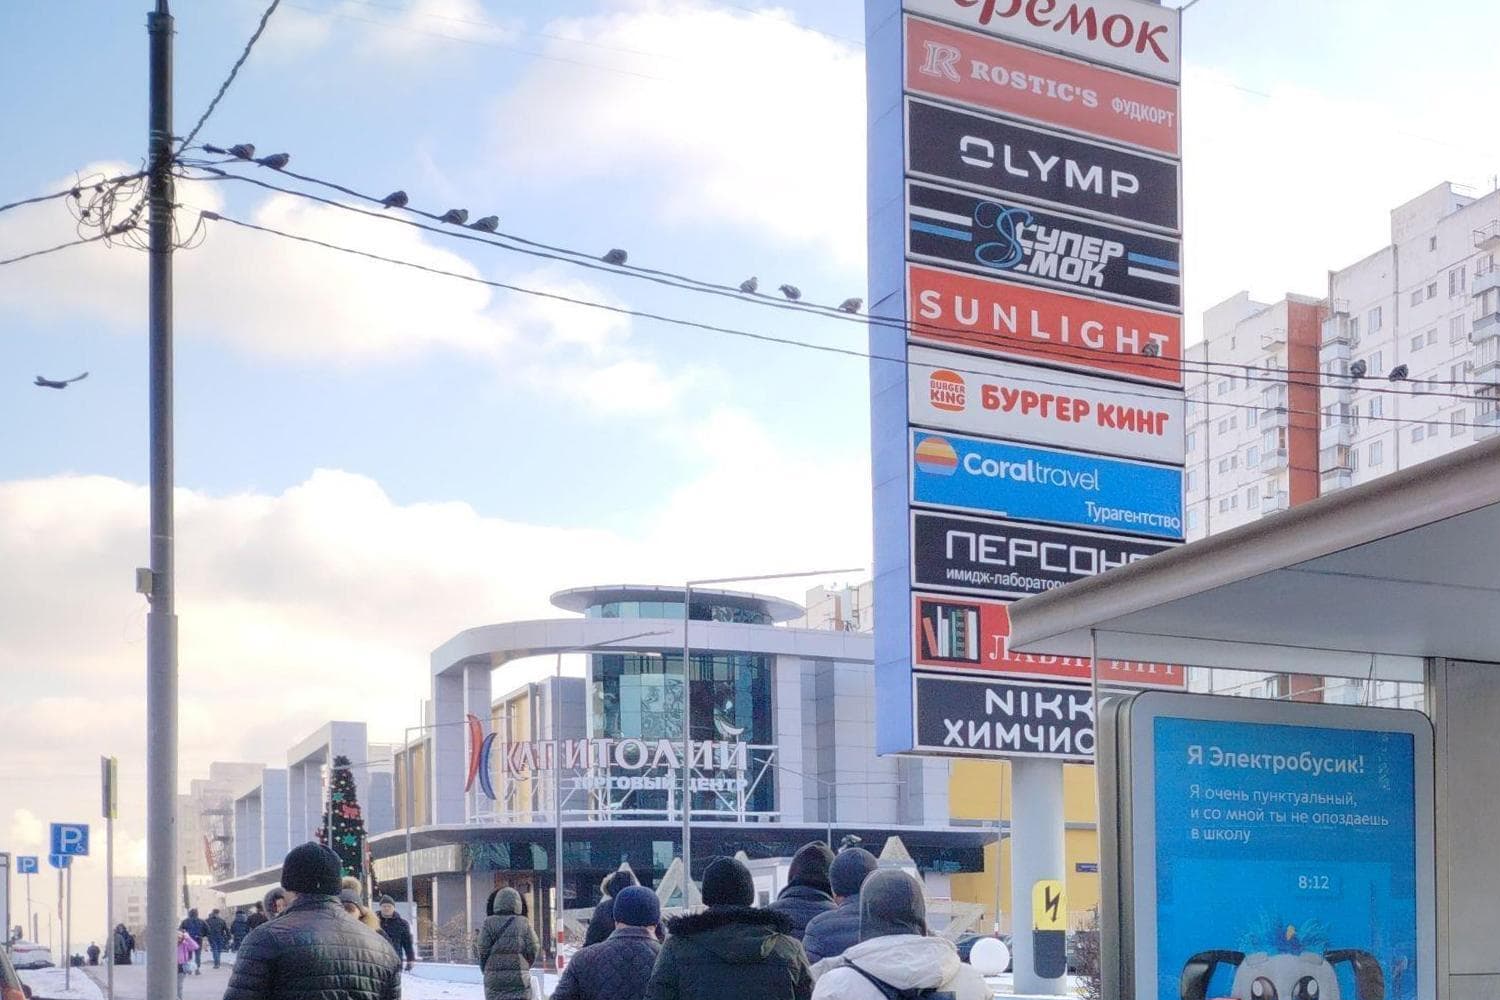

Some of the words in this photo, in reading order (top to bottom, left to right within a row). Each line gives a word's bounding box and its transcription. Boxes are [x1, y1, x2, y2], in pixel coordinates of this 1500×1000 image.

[952, 0, 1170, 63] ремок
[970, 59, 1099, 109] ROSTIC'S
[1111, 97, 1175, 128] ФУДКОРТ
[960, 135, 1140, 198] OLYMP
[1015, 222, 1124, 263] СУПЕР
[919, 289, 1169, 357] SUNLIGHT
[930, 380, 965, 395] BURGER
[930, 389, 965, 406] KING
[981, 384, 1090, 423] БУРГЕР
[1097, 402, 1169, 436] КИНГ
[1084, 500, 1180, 530] Турагентство
[946, 567, 1067, 591] имидж-лаборатор
[985, 688, 1096, 721] NIKK
[501, 722, 747, 781] КАПИТОЛИЙ
[943, 718, 1095, 754] ХИМЧИС
[1187, 745, 1203, 765] Я
[1209, 746, 1364, 776] Электробусик!
[1190, 784, 1200, 798] Я
[1205, 788, 1249, 801] очень
[1253, 790, 1358, 807] пунктуальный,
[1190, 809, 1199, 819] и
[1203, 808, 1221, 820] со
[1226, 807, 1264, 822] мной
[1269, 811, 1286, 823] ты
[1291, 812, 1309, 824] не
[1312, 813, 1389, 827] опоздаешь
[1191, 829, 1200, 840] в
[1203, 828, 1251, 844] школу
[1298, 875, 1329, 889] 8:12
